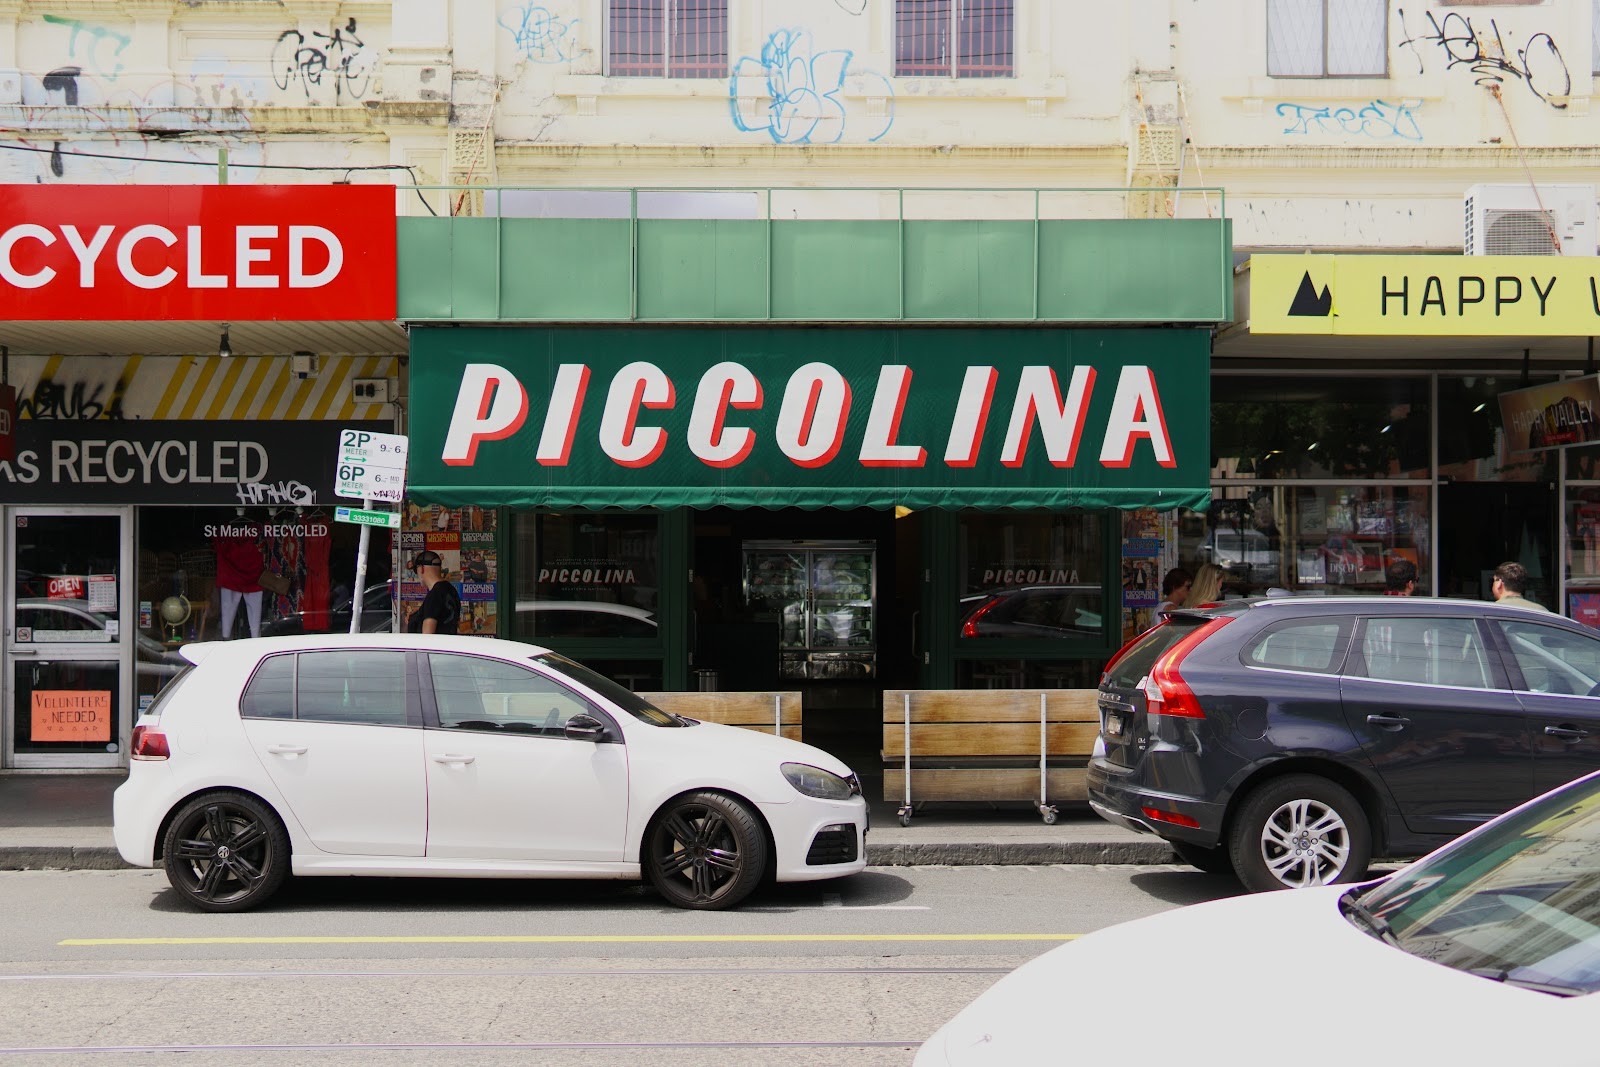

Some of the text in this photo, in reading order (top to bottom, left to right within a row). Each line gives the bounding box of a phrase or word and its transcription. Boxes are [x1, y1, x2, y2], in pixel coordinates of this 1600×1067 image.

[0, 224, 344, 289] CYCLED
[1381, 275, 1557, 317] HAPPY
[441, 361, 1178, 467] PICCOLINA
[1511, 399, 1594, 434] HAPPY VALLEY
[343, 431, 371, 448] 2P
[52, 439, 269, 484] RECYCLED
[339, 465, 365, 482] 6P
[203, 525, 328, 538] St Marks RECYCLED
[50, 577, 80, 593] OPEN
[538, 569, 637, 585] PICCOLINA
[983, 569, 1080, 585] PICCOLINA
[35, 694, 107, 708] VOLUNTEERS
[52, 711, 96, 723] NEEDED
